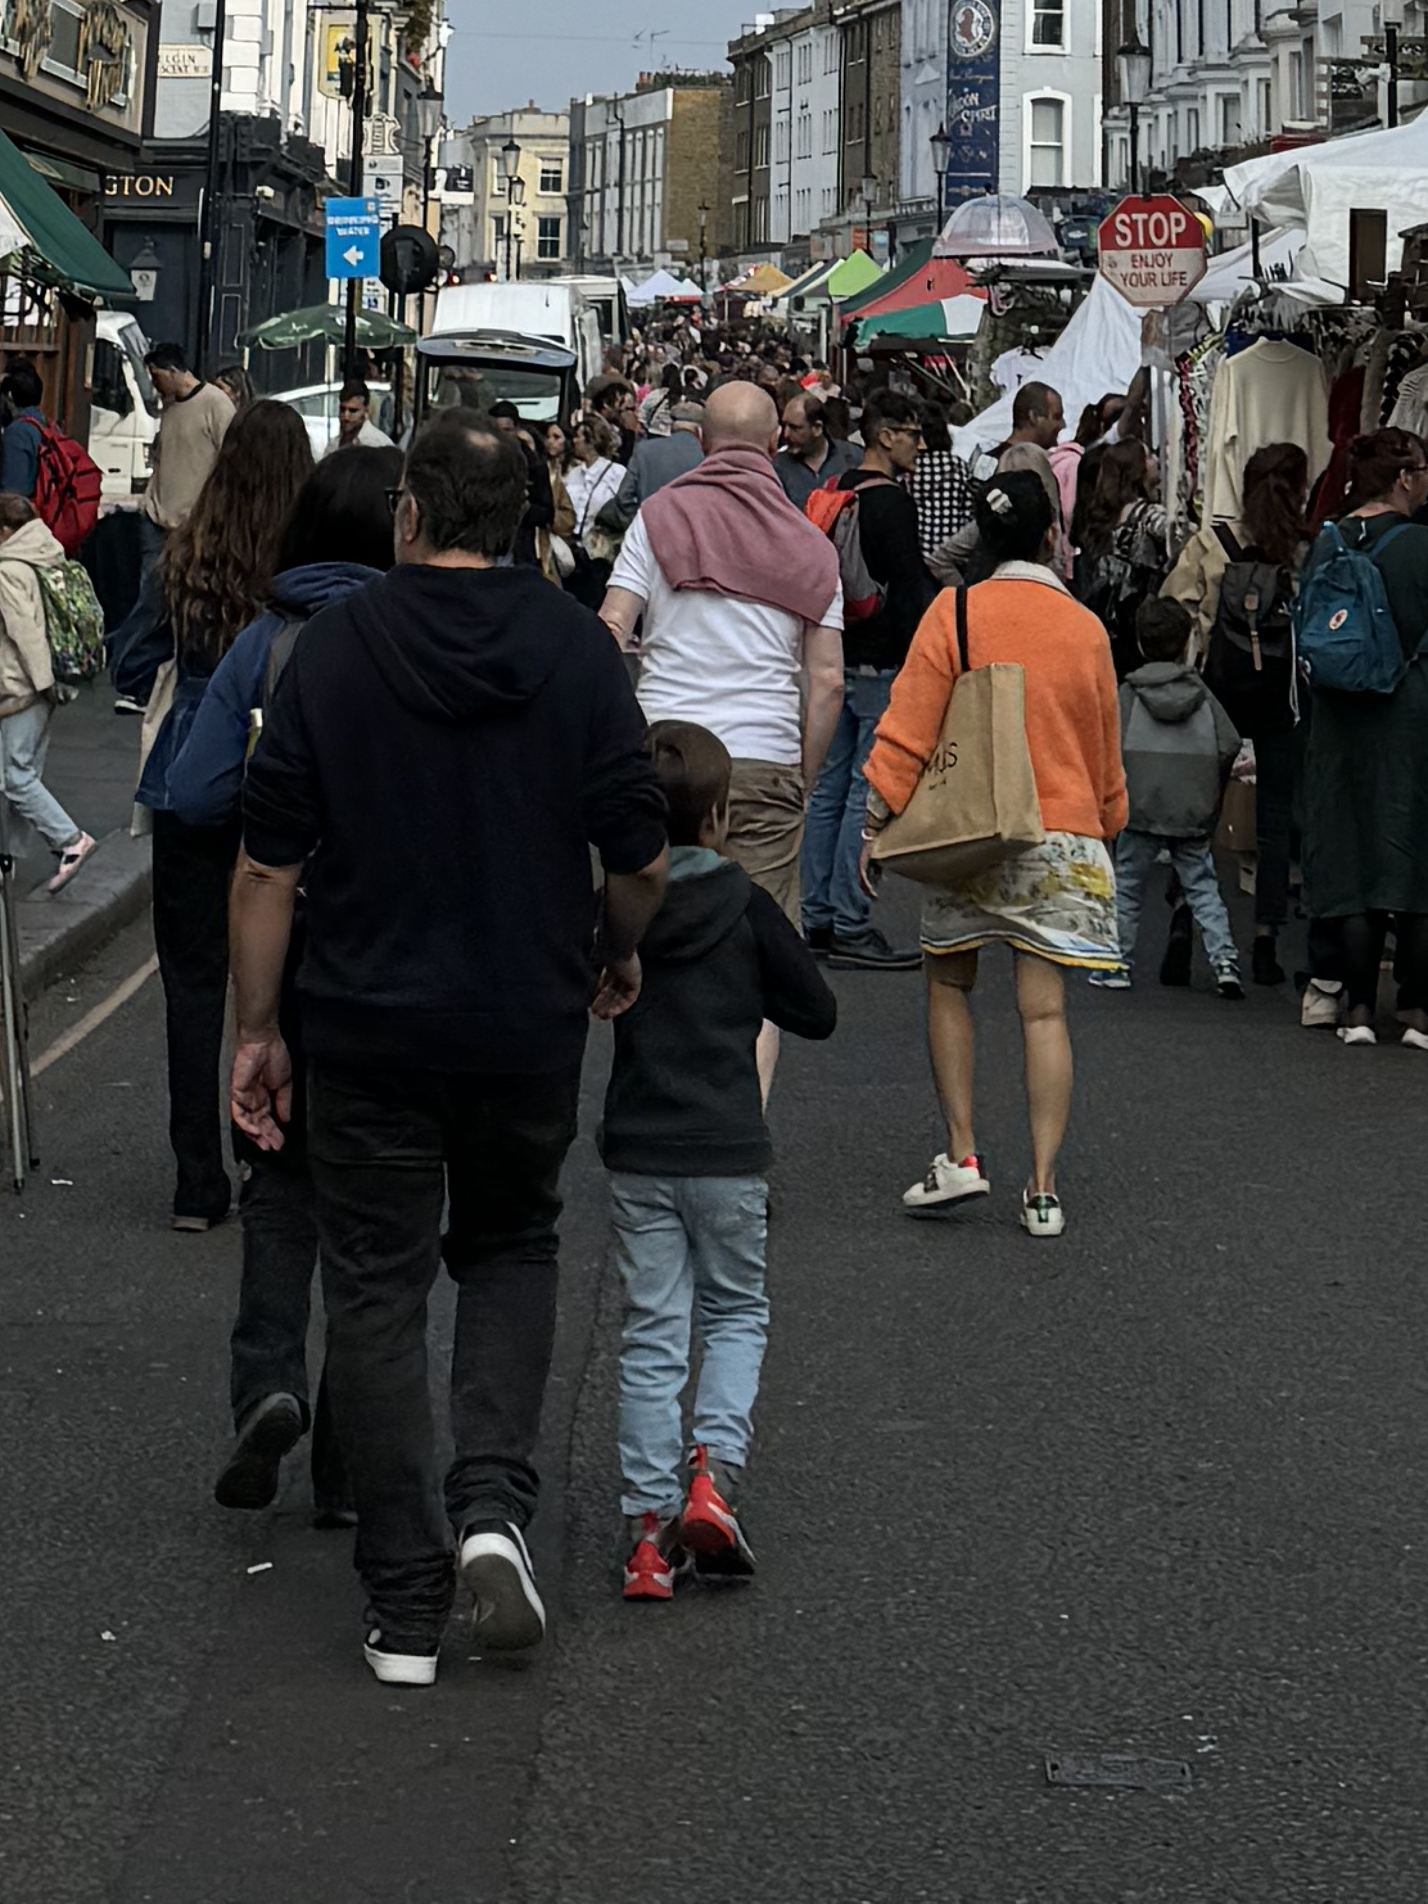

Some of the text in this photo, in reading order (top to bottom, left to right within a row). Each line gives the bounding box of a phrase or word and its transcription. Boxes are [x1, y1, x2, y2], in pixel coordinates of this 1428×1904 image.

[104, 175, 174, 196] GTON
[1115, 211, 1187, 248] STOP
[1131, 252, 1174, 269] ENJOY
[1121, 271, 1188, 287] YOUR LIFE
